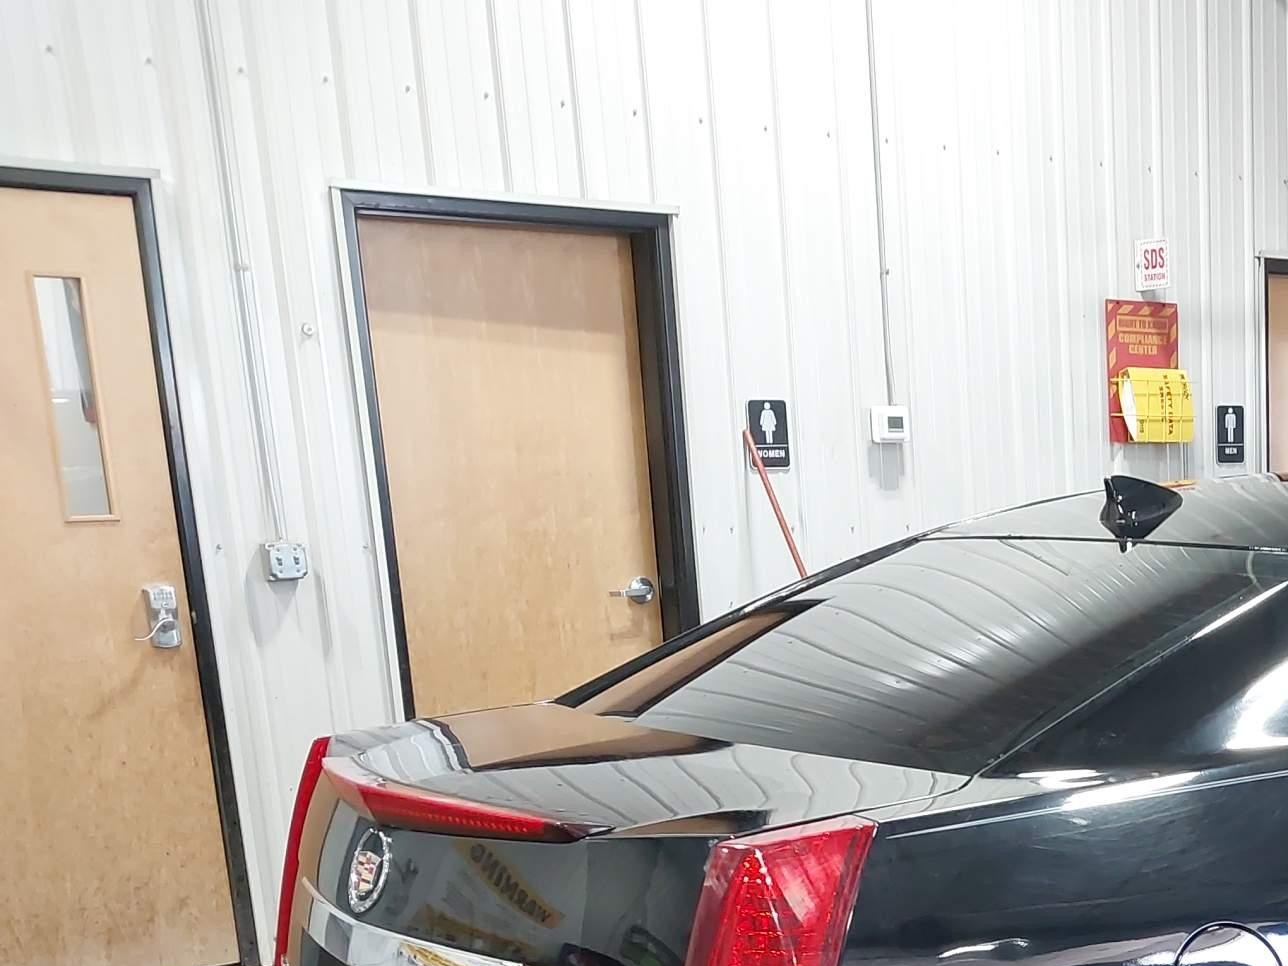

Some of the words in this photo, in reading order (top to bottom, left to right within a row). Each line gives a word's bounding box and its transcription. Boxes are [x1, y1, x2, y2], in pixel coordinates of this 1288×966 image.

[1143, 246, 1165, 270] SDS
[1144, 272, 1166, 281] STATION
[1118, 333, 1168, 345] COMPLIANCE
[1128, 345, 1157, 355] CENTER
[1224, 447, 1238, 455] MEN
